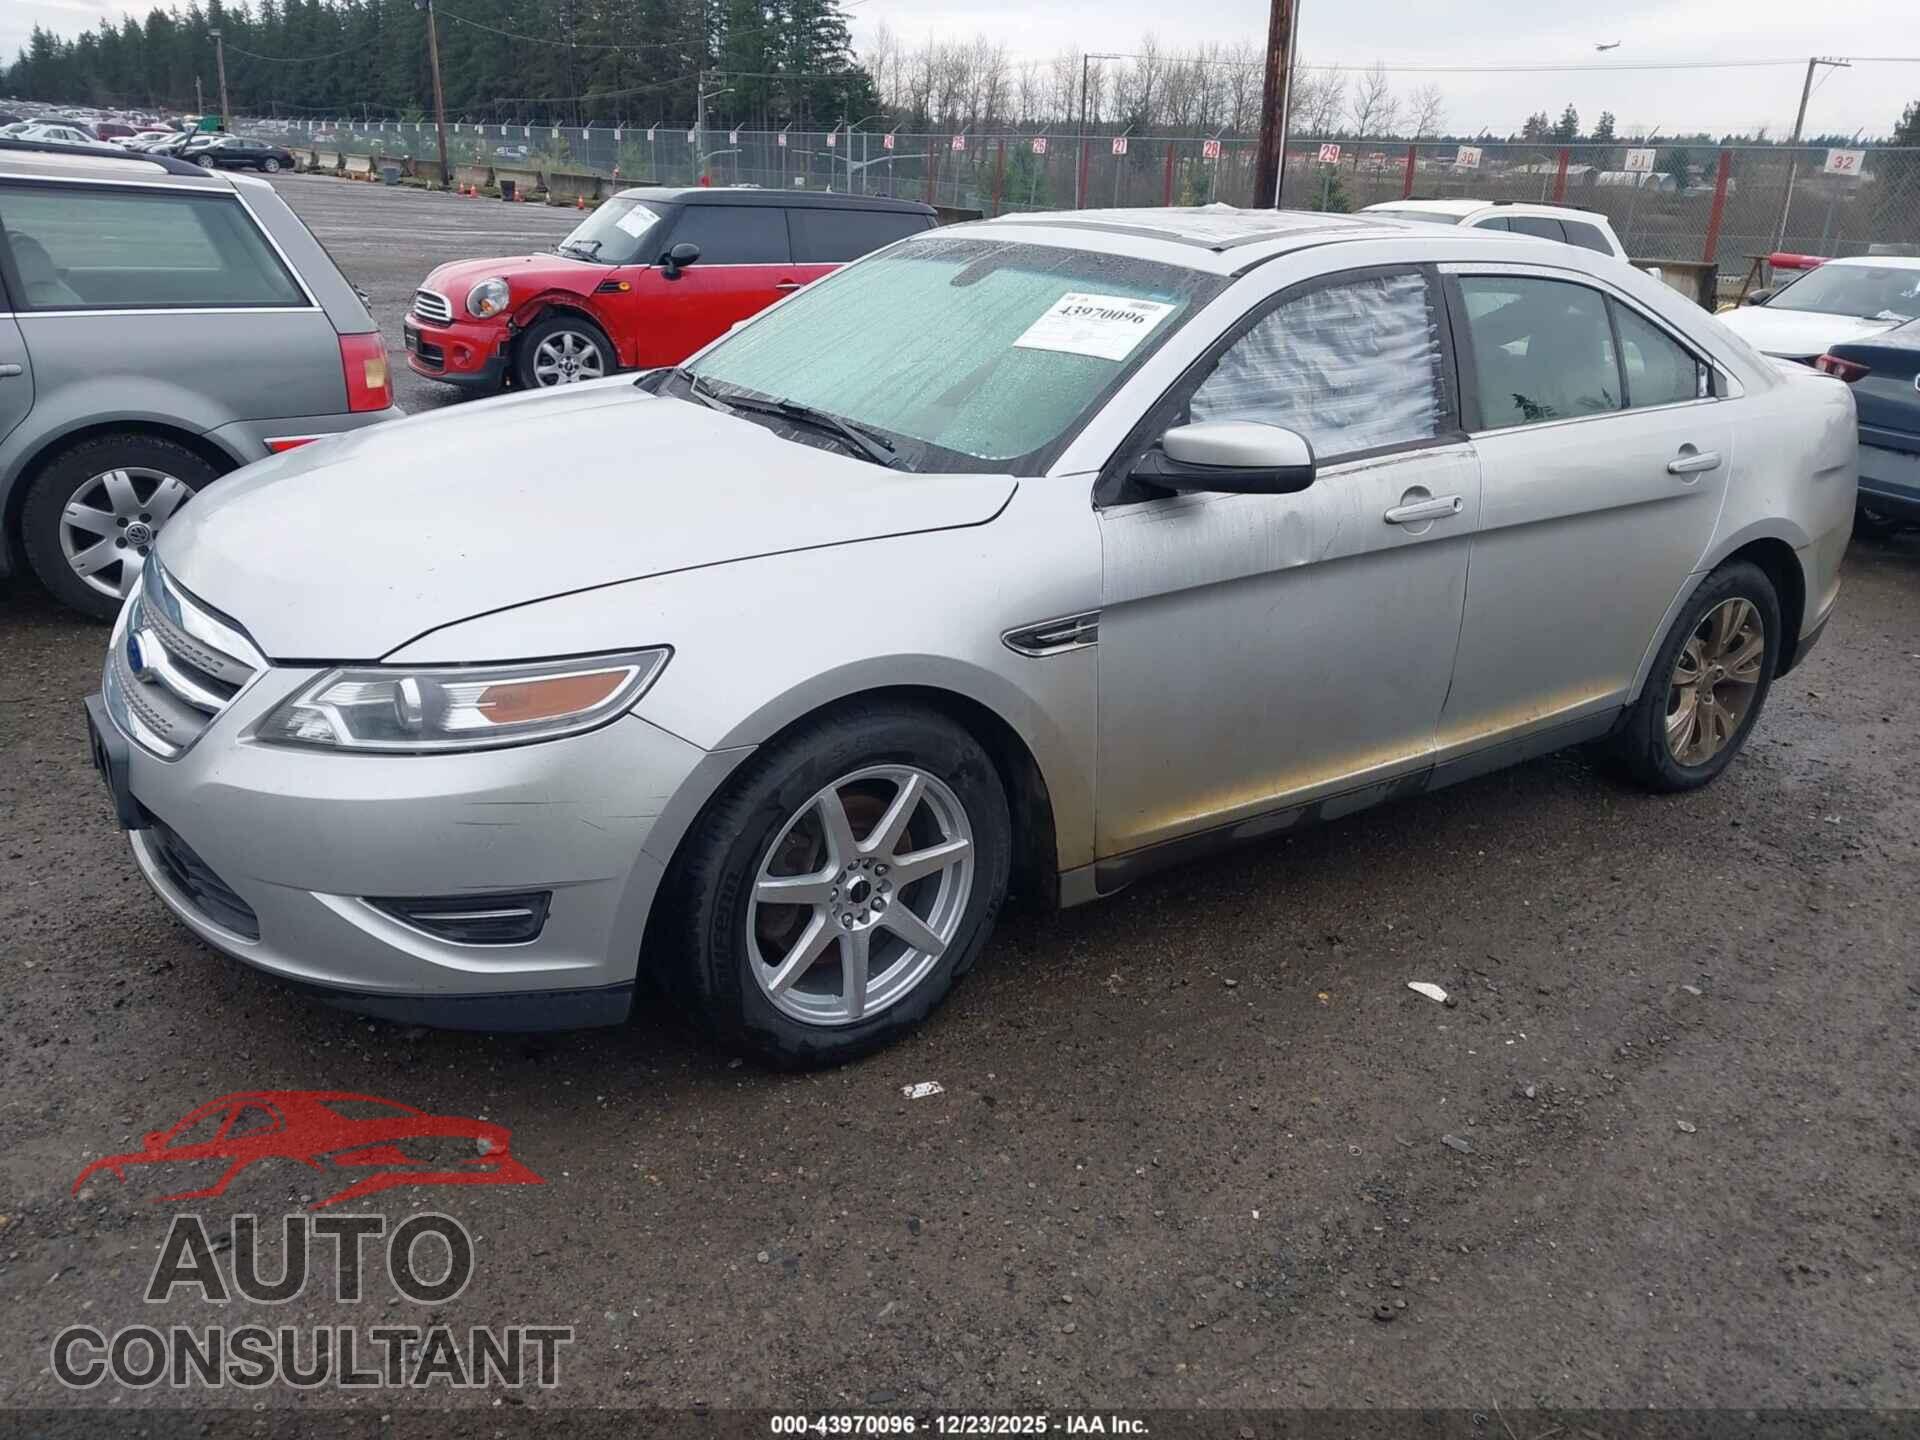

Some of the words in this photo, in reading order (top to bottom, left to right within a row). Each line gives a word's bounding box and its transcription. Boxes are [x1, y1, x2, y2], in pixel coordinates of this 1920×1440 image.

[1114, 139, 1125, 153] 27
[1205, 142, 1219, 157] 28
[1321, 146, 1338, 161] 29
[1461, 152, 1473, 164] 30
[1632, 154, 1645, 166] 31
[1835, 155, 1854, 168] 32
[1059, 305, 1145, 324] 43970096
